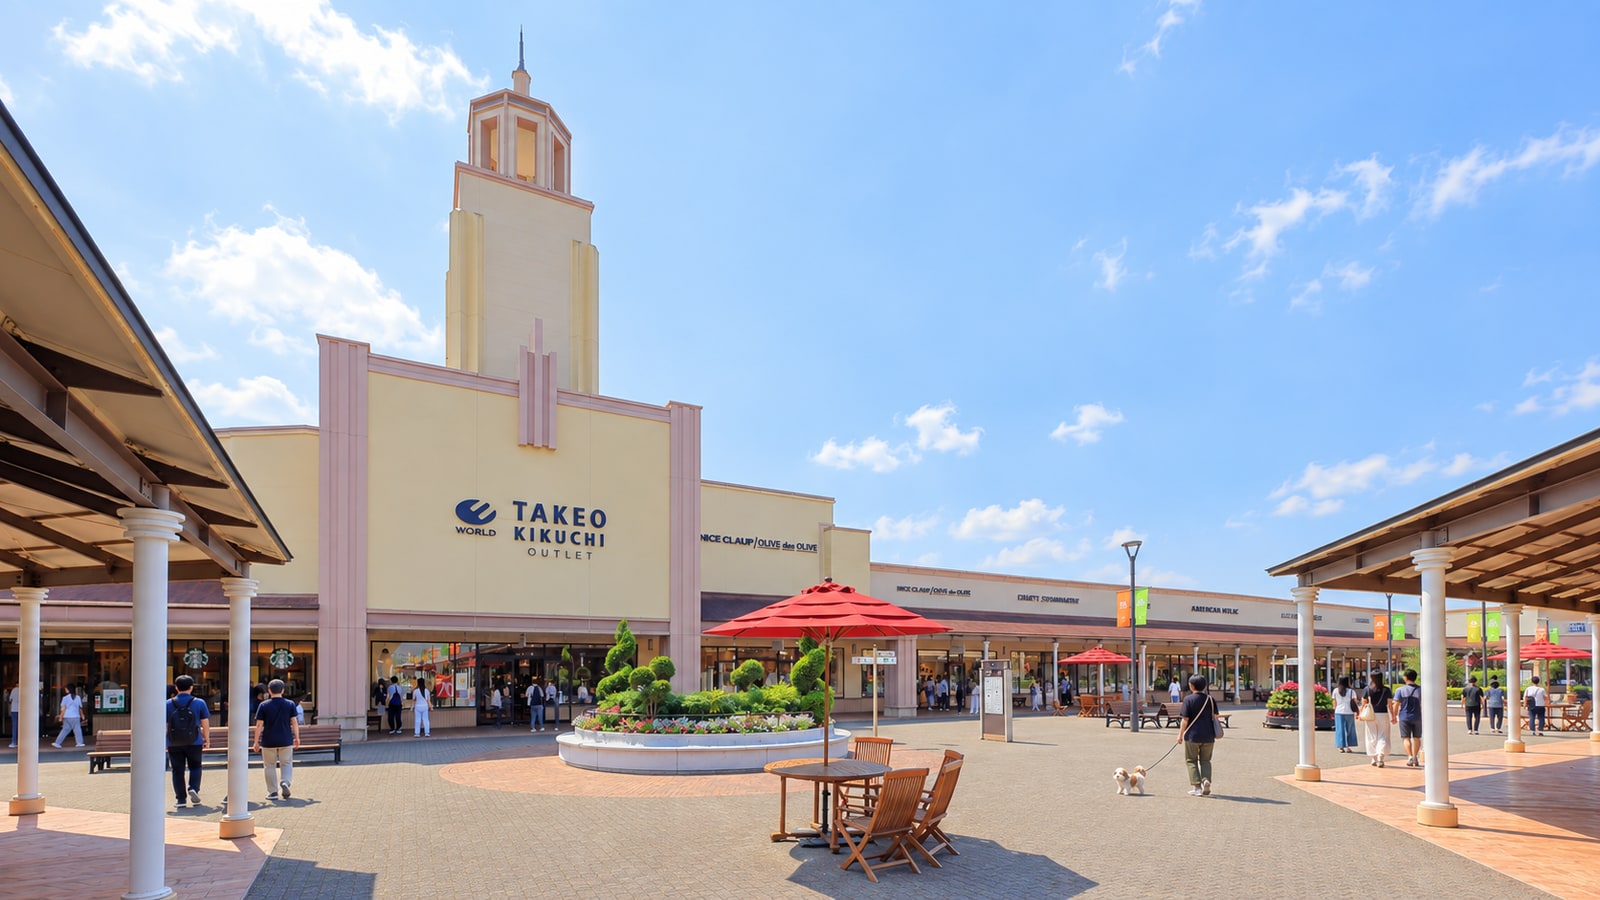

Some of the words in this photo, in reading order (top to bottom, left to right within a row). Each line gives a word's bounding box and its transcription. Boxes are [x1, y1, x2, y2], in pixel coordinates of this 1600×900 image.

[512, 500, 607, 529] TAKEO
[455, 526, 497, 537] WORLD
[514, 526, 605, 547] KIKUCHI
[700, 533, 721, 543] NICE
[796, 543, 818, 552] OLIVE
[527, 547, 593, 560] OUTLET
